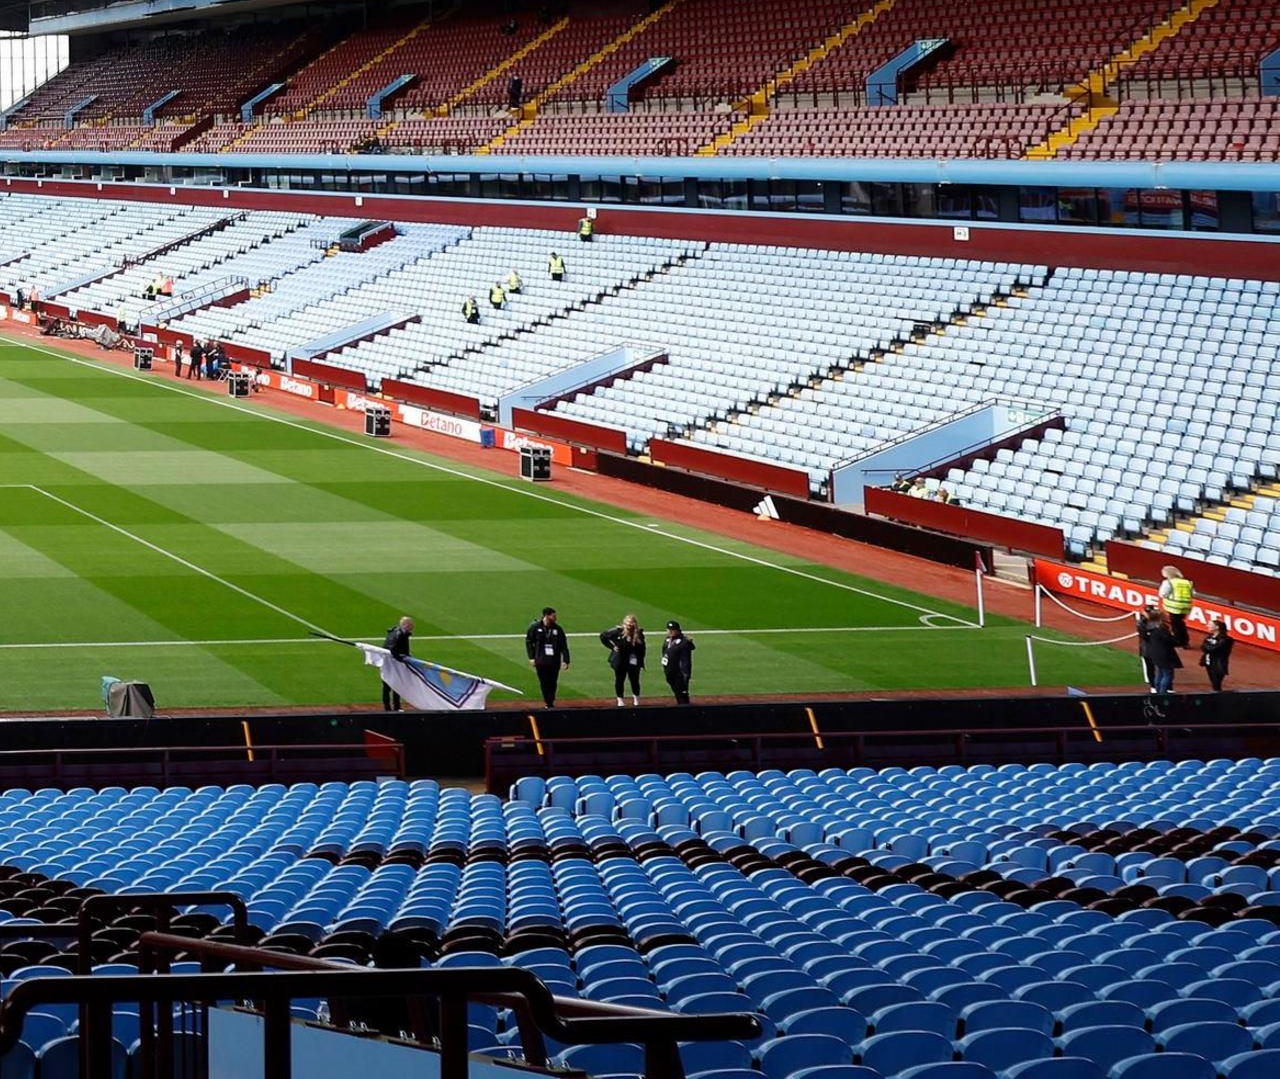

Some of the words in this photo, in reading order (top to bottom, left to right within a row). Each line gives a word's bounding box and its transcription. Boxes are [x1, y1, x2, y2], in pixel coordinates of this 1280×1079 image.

[280, 375, 313, 398] Betano
[420, 411, 463, 436] Betano
[1075, 576, 1159, 610] TRADE
[1188, 606, 1276, 643] ATION
